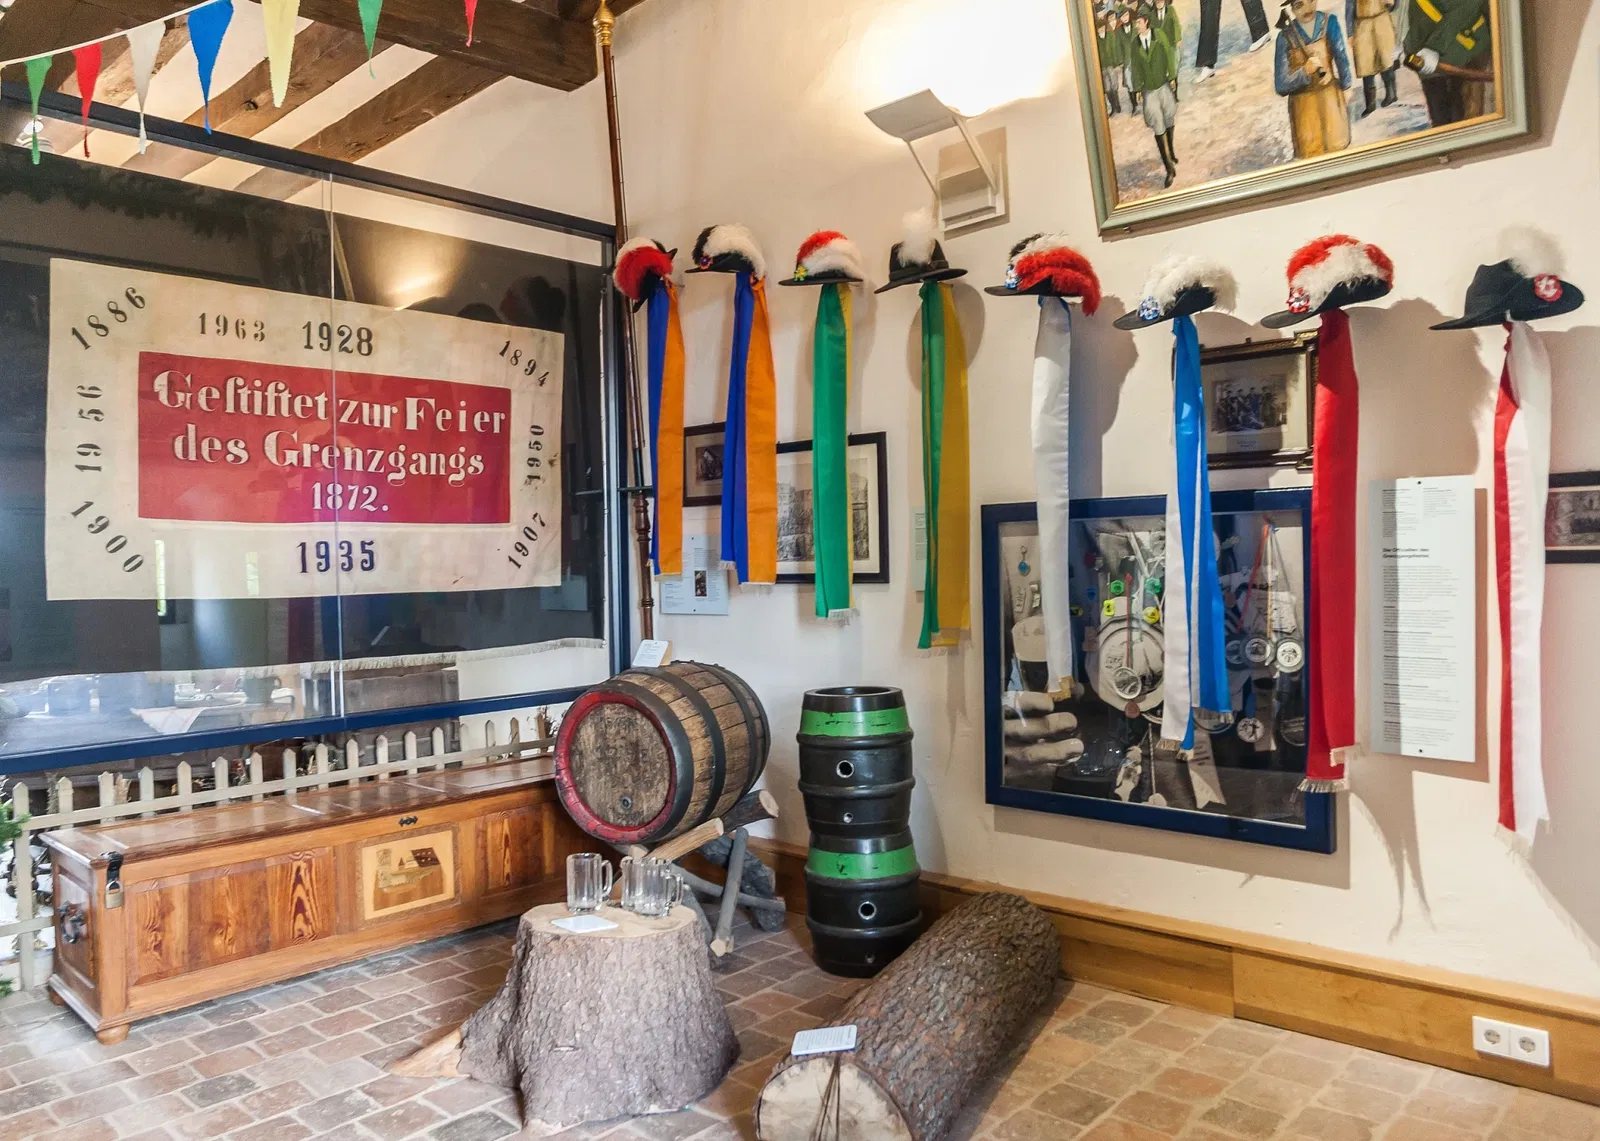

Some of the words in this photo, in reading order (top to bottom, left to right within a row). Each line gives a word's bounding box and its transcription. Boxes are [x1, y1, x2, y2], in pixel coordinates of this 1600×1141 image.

[71, 286, 147, 350] 1886
[199, 311, 266, 343] 1963
[302, 320, 375, 357] 1928
[498, 340, 550, 388] 1894
[74, 385, 105, 474] 1956
[339, 398, 399, 428] zur
[404, 397, 506, 434] Feier
[173, 423, 250, 464] des
[263, 429, 486, 488] Grenzgangs
[528, 424, 545, 481] 1950
[312, 481, 390, 512] 1872.
[70, 500, 145, 573] 1900
[296, 540, 375, 574] 1935
[507, 512, 547, 570] 1907
